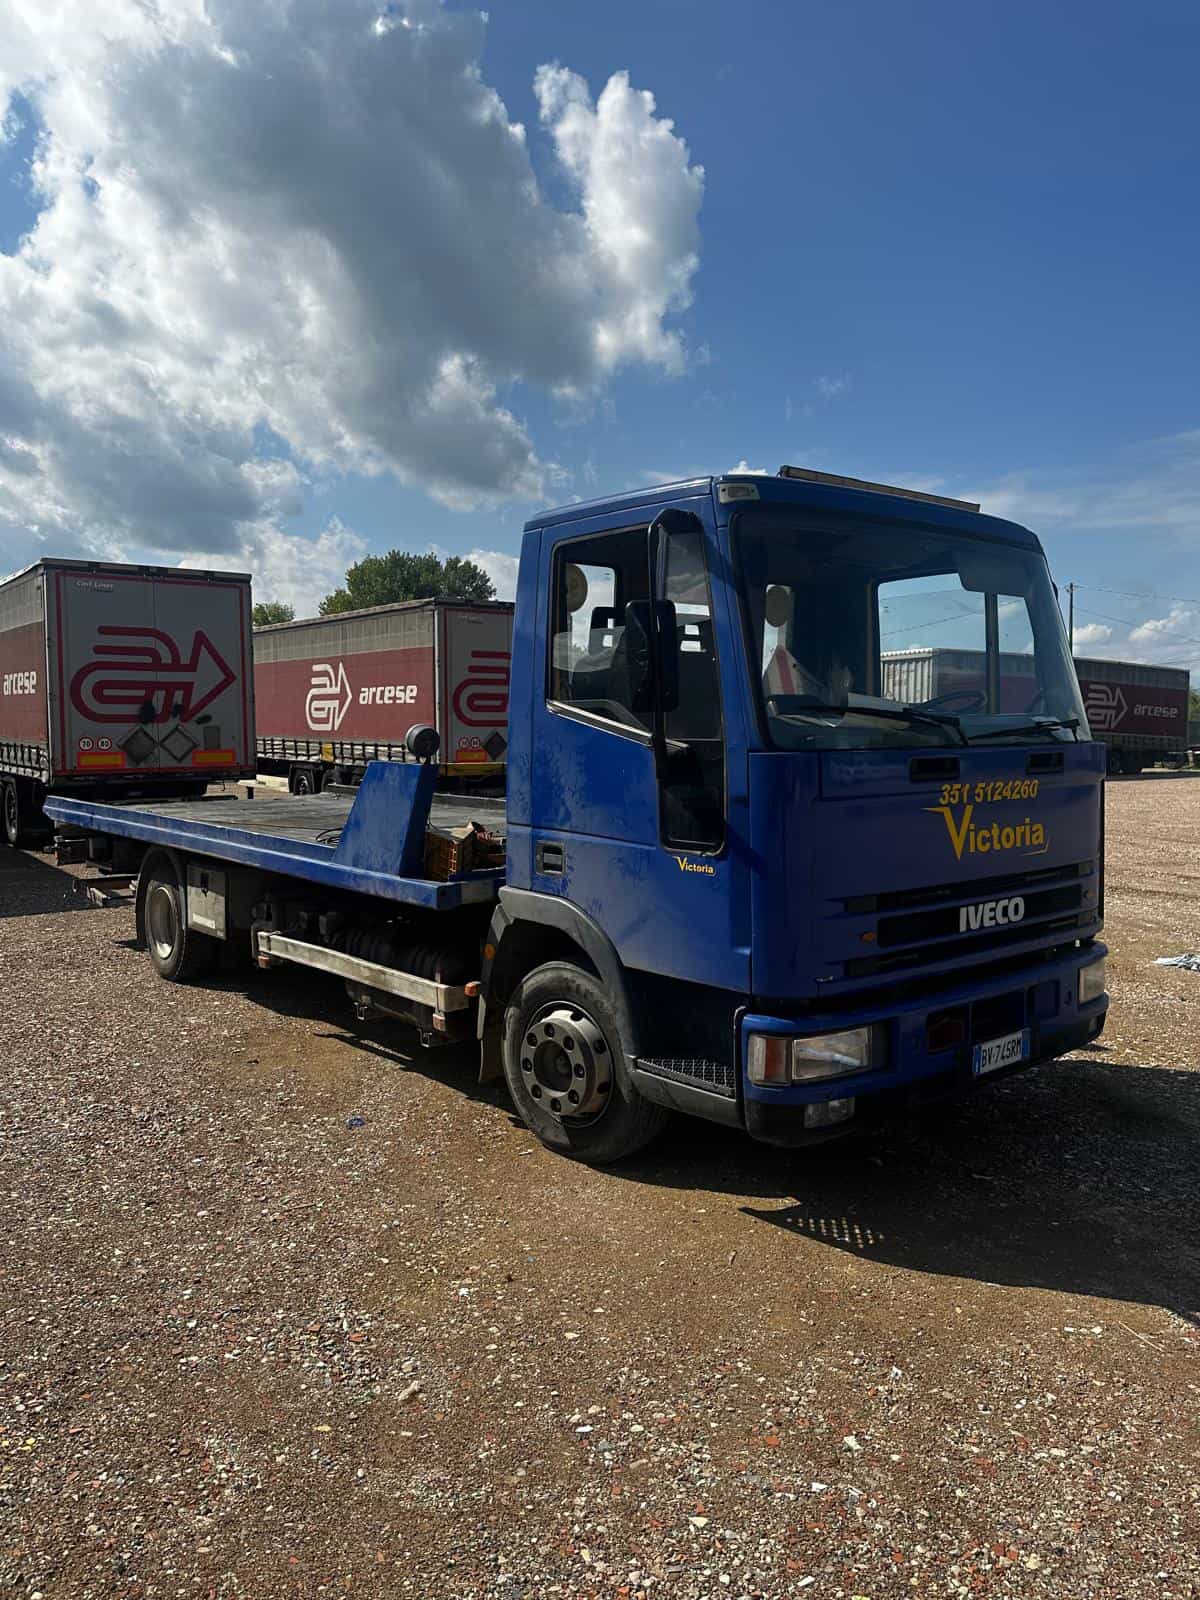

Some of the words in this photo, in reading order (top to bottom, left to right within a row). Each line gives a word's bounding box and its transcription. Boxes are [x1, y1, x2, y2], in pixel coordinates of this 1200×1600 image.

[3, 671, 37, 696] arcese
[359, 685, 418, 705] arcese
[1133, 704, 1179, 719] arcese
[939, 783, 970, 805] 351
[974, 779, 1040, 803] 5124260
[920, 805, 1048, 861] Victoria
[672, 856, 715, 874] Victoria
[959, 897, 1025, 932] IVECO
